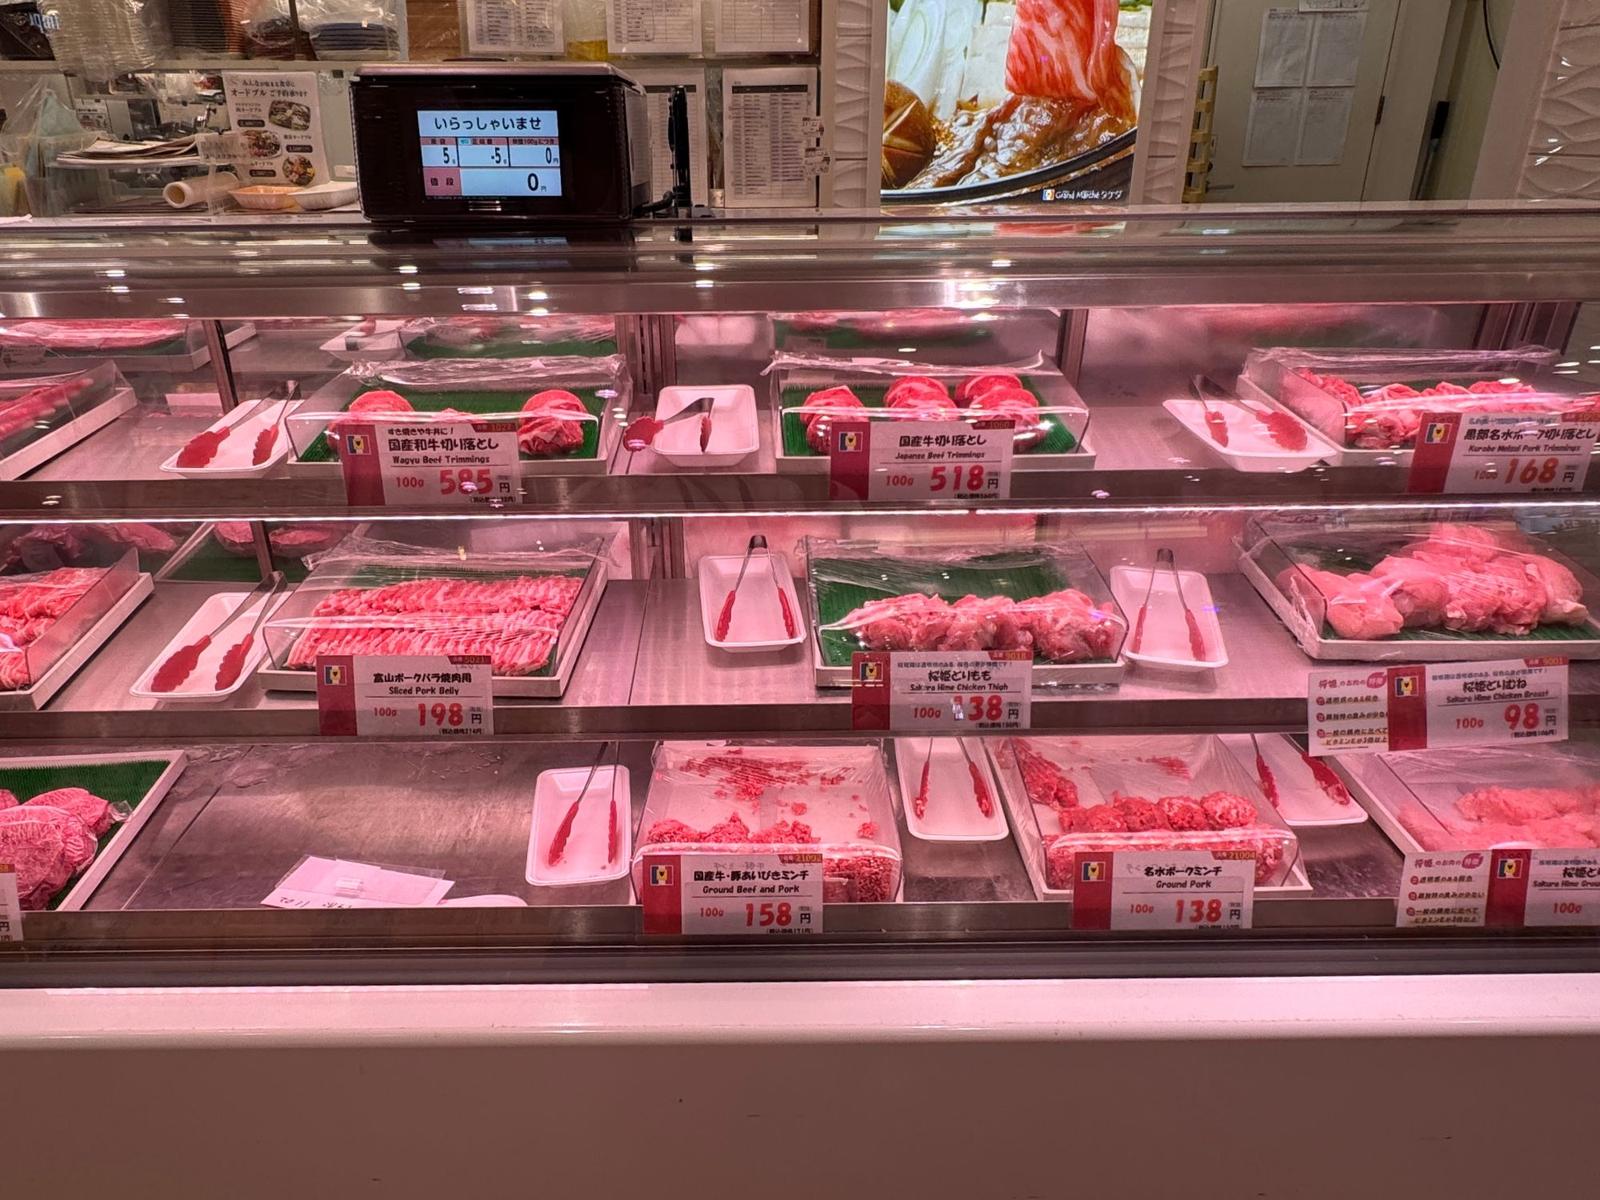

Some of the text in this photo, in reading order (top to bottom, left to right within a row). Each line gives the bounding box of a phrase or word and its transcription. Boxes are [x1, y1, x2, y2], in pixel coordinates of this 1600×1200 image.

[434, 117, 542, 130] いらっしゃいませ
[545, 147, 552, 164] 0
[527, 173, 539, 191] 0
[388, 438, 499, 452] 国産和牛切り落とし
[899, 435, 986, 447] 国産牛切り落とし
[393, 455, 490, 465] Wagyu Beef Trimmings
[947, 451, 985, 460] Trimmings
[1504, 458, 1559, 485] 168
[1562, 472, 1574, 482] 円
[396, 468, 510, 495] 100g 585 円
[885, 475, 914, 486] 100g
[930, 465, 984, 492] 518
[988, 478, 998, 489] 円
[374, 673, 472, 683] 富山ポークバラ焼肉用
[928, 670, 992, 682] 桜姫とりもも
[389, 687, 459, 696] Sliced Pork Belly
[957, 683, 986, 691] Chicken
[988, 683, 1008, 692] Thigh
[1462, 678, 1527, 693] 桜姫とりむね
[1493, 692, 1522, 700] Chicken
[374, 707, 397, 717] 100g
[418, 703, 463, 726] 198
[471, 713, 482, 724] 円
[913, 707, 941, 718] 100g
[1008, 709, 1019, 719] 円
[1455, 718, 1484, 729] 100g
[1504, 703, 1540, 730] 98
[1545, 715, 1556, 727] 円
[694, 870, 809, 882] 国産牛・豚あいびきミンチ
[1144, 866, 1222, 877] 名水ポークミンチ
[703, 885, 800, 894] Ground Beef and Pork
[1156, 880, 1211, 889] Ground Pork
[1130, 904, 1154, 914] 100g
[1175, 899, 1222, 923] 138
[1230, 908, 1241, 920] 円
[1553, 902, 1582, 913] 100g
[700, 902, 811, 926] 100g 158 円
